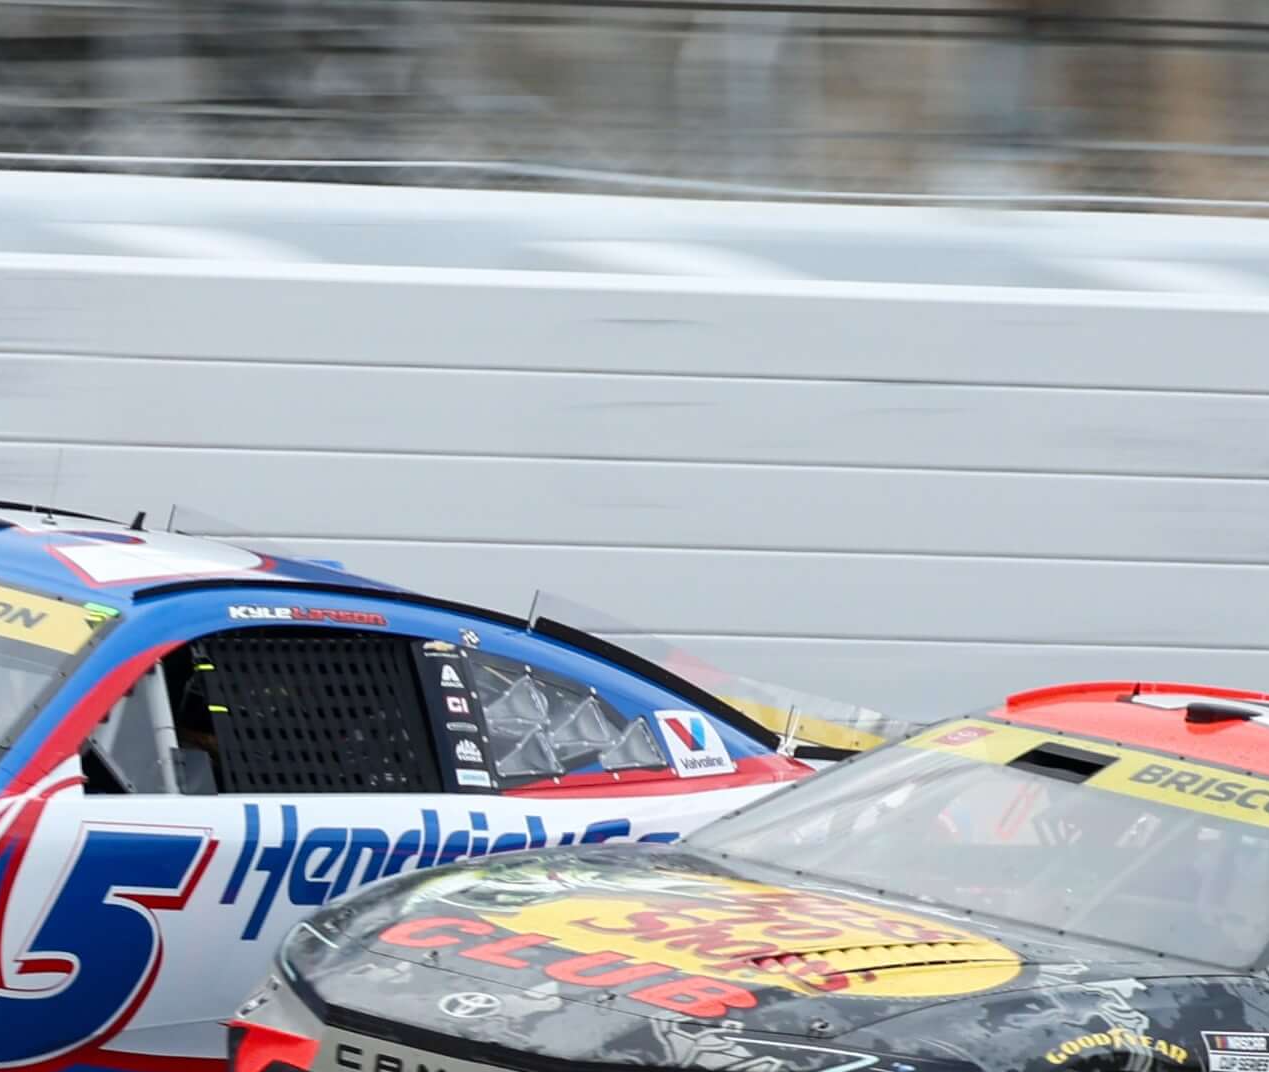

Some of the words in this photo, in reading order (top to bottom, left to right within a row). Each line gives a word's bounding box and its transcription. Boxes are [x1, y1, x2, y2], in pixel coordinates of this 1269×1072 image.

[228, 606, 292, 620] KYLE
[378, 916, 759, 1018] CLUB
[1045, 1025, 1189, 1065] GOODYEAR
